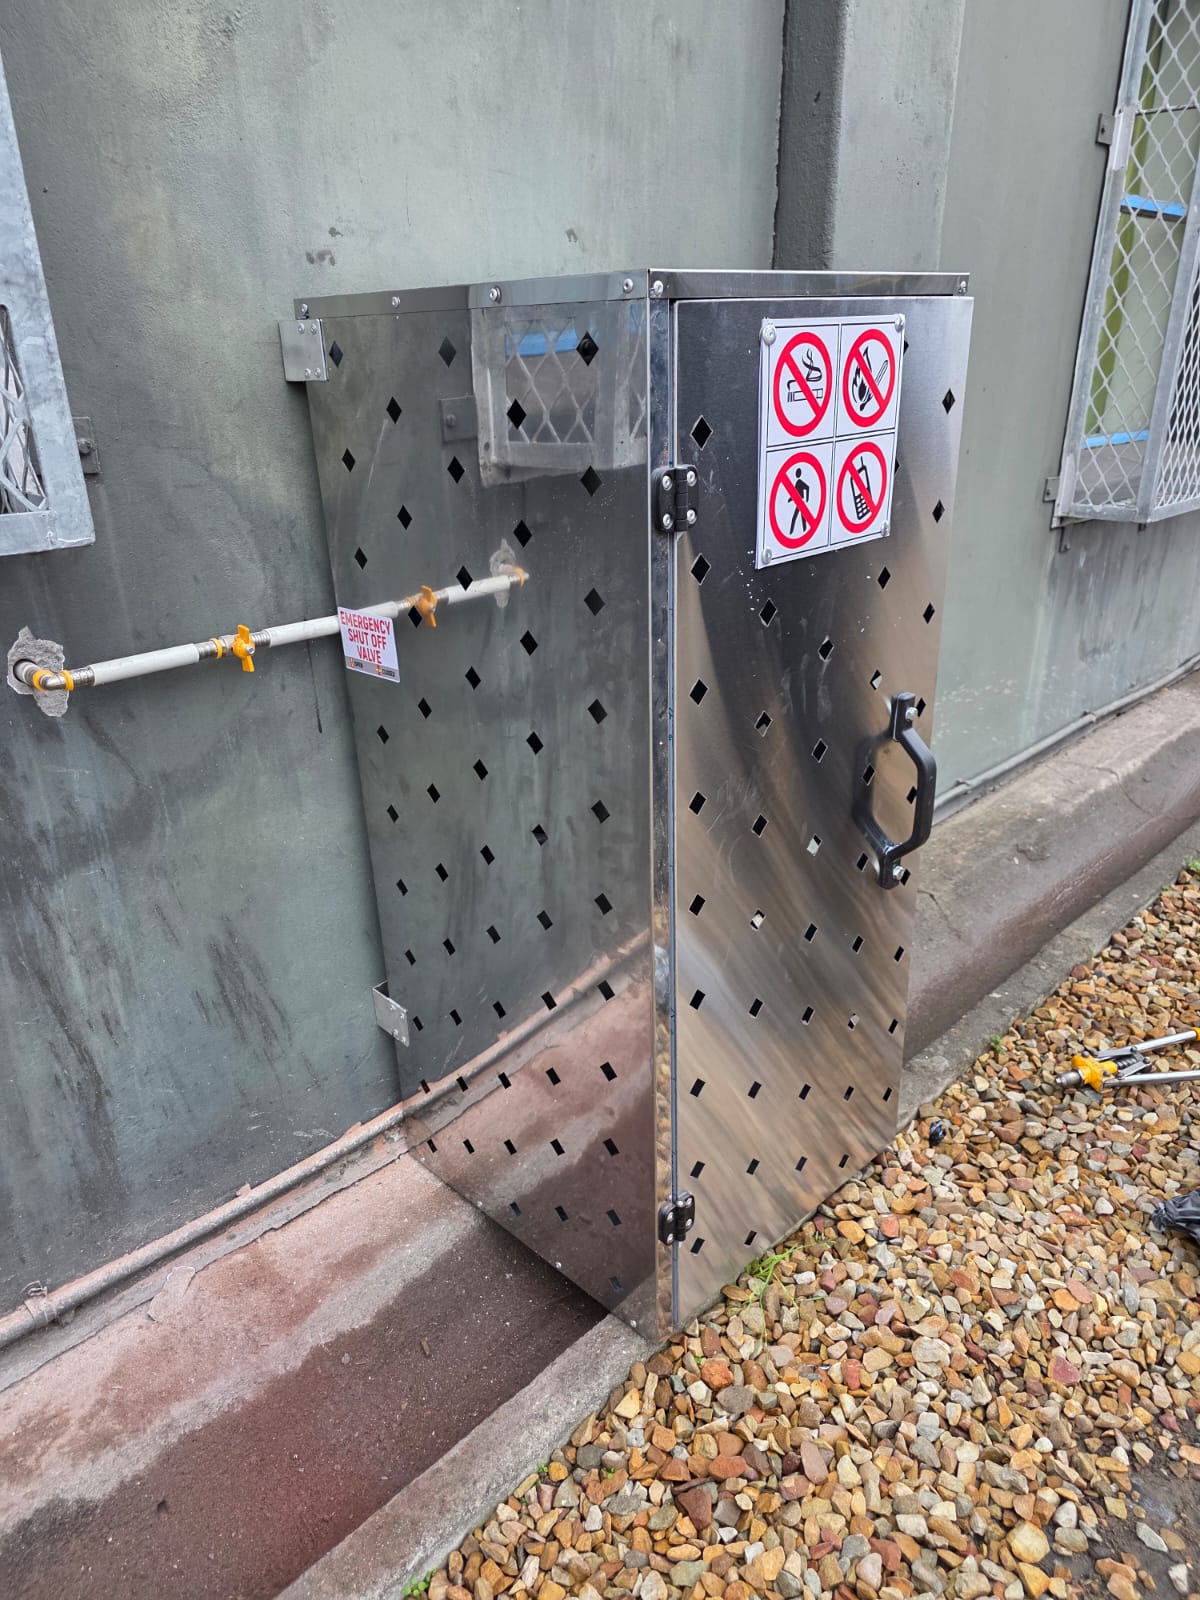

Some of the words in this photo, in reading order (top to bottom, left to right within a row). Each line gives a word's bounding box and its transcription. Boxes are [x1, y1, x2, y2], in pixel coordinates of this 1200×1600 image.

[340, 611, 391, 635] EMERGENCY
[347, 628, 368, 645] SHUT
[371, 634, 387, 650] OFF
[357, 646, 382, 664] VALVE
